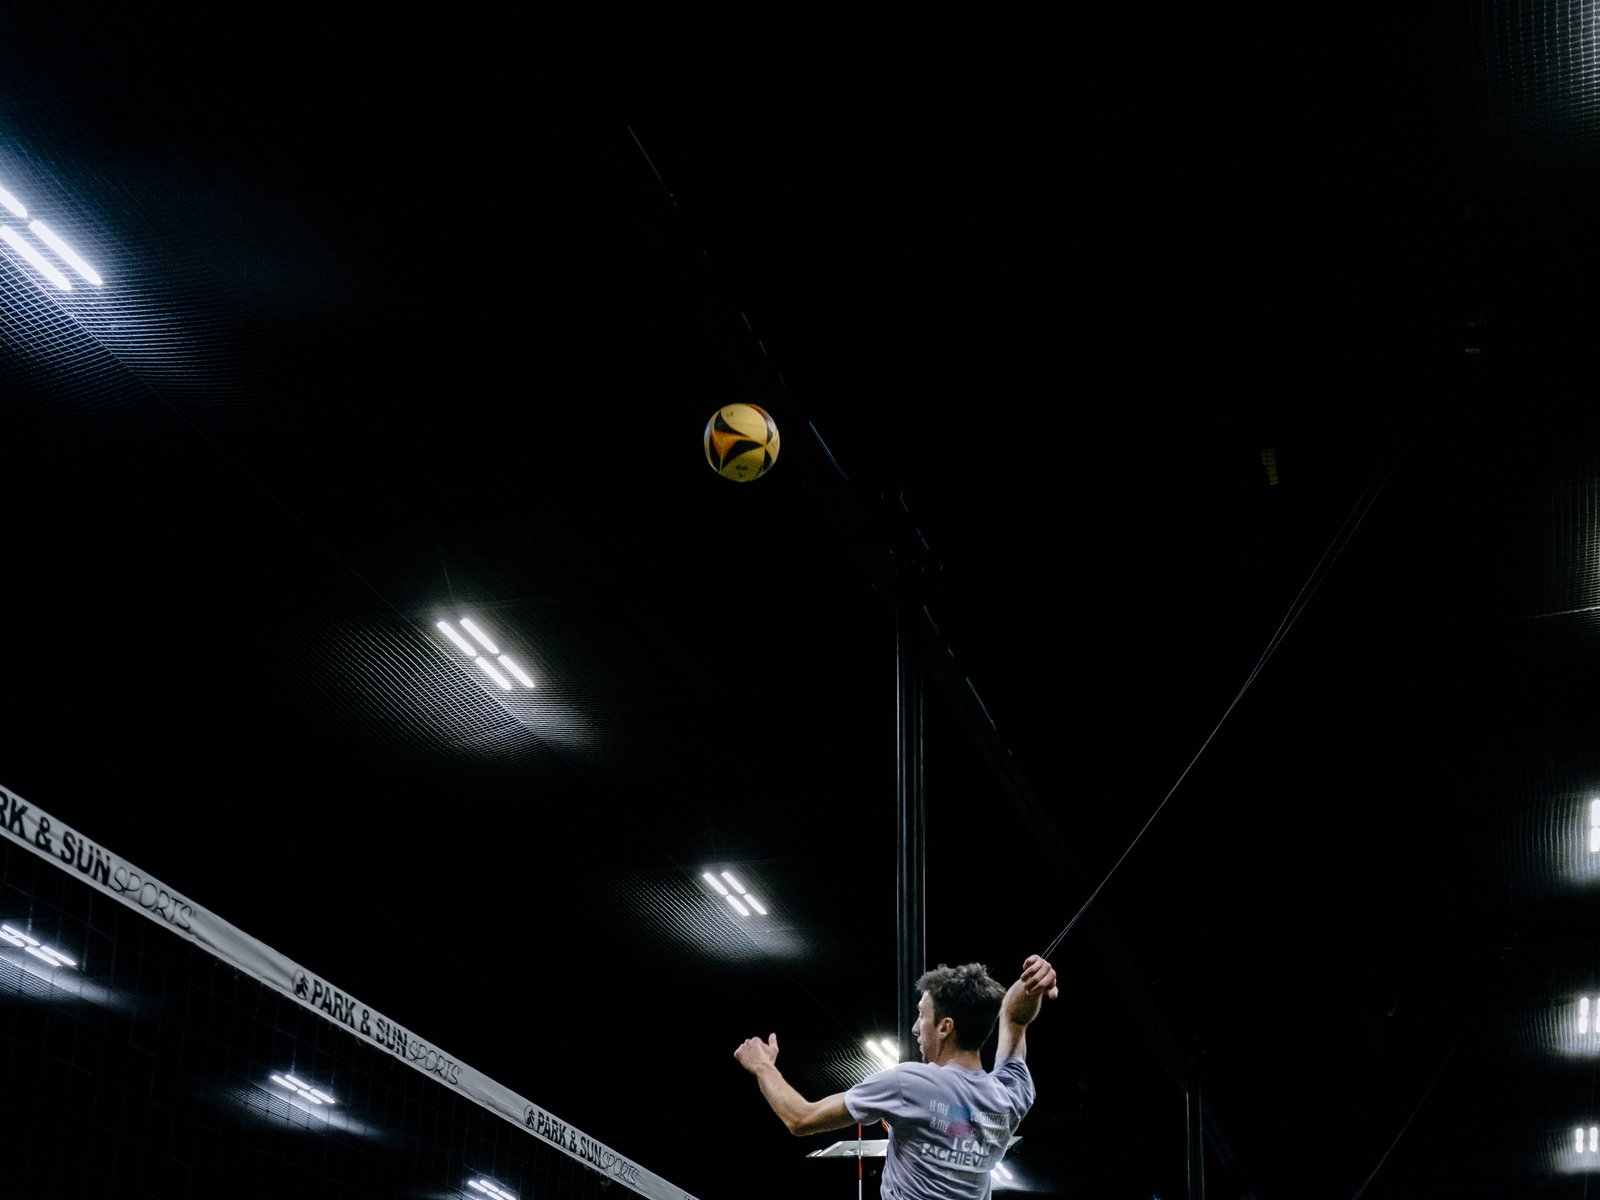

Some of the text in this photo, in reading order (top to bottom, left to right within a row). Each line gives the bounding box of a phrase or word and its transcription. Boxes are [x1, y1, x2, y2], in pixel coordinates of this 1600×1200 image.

[35, 816, 53, 852] &
[311, 979, 356, 1029] PARK
[361, 1009, 371, 1036] &
[537, 1110, 566, 1148] PARK
[569, 1130, 577, 1153] &
